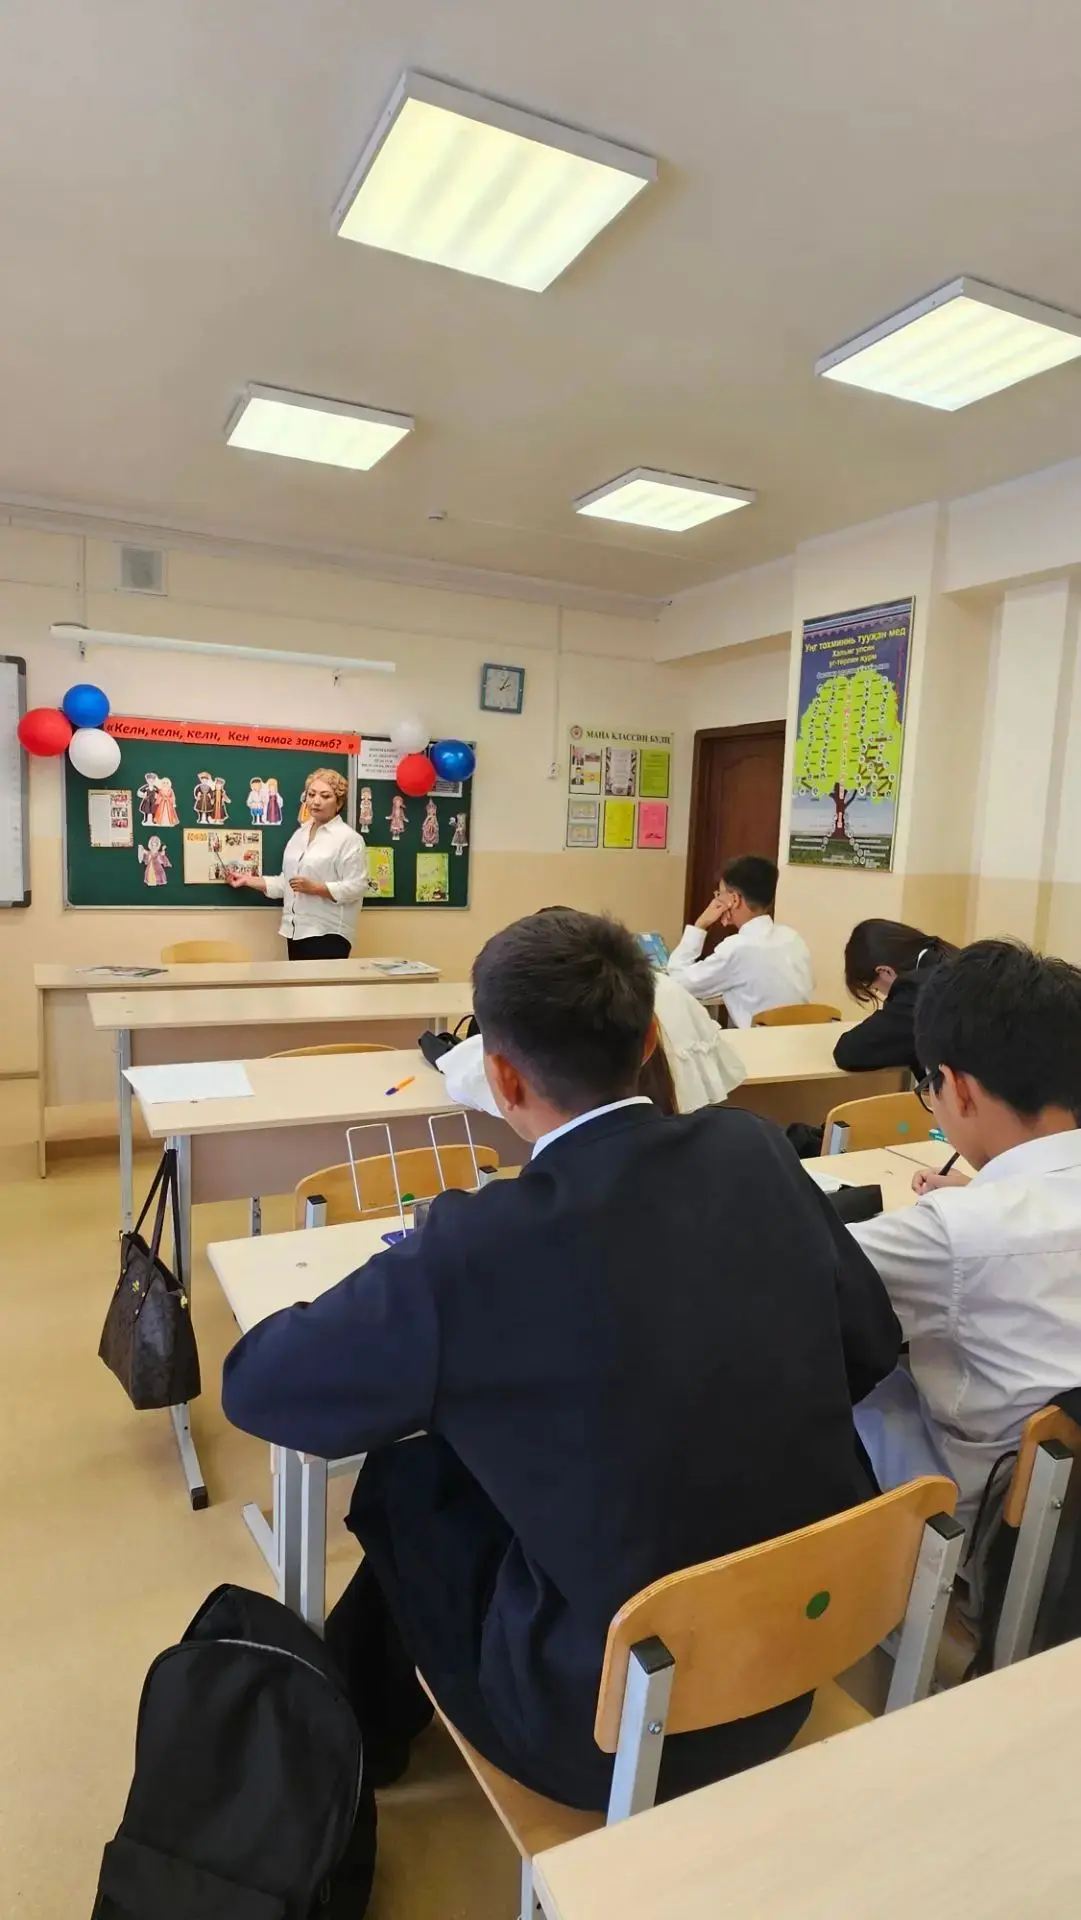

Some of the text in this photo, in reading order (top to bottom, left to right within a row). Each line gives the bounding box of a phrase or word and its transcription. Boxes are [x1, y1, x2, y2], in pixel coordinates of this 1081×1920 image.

[106, 722, 149, 737] «Келн,
[150, 727, 184, 740] келн,
[186, 729, 221, 742] келн,
[227, 731, 249, 741] Кен
[257, 735, 292, 746] чамаг
